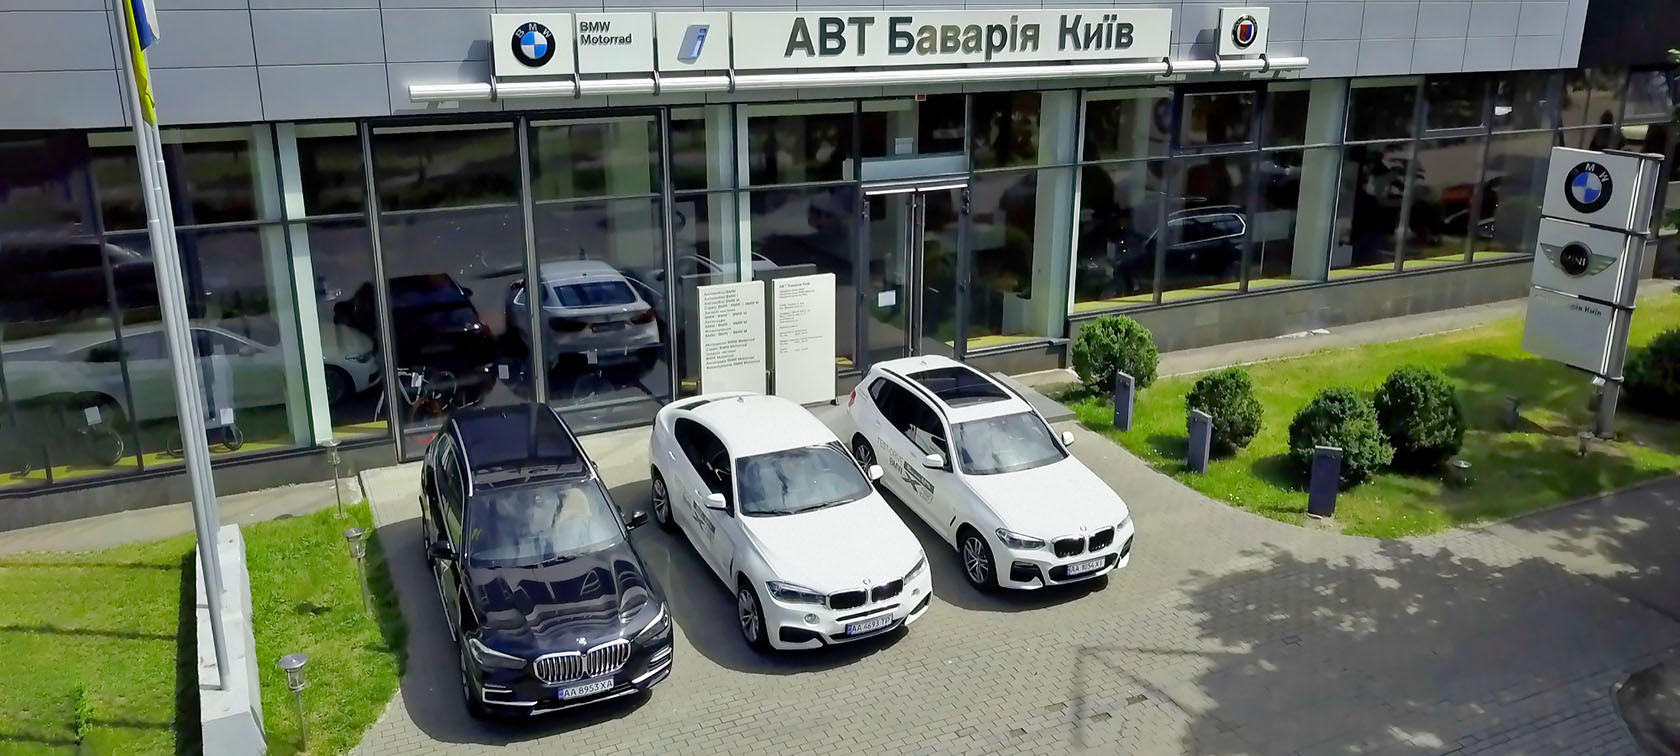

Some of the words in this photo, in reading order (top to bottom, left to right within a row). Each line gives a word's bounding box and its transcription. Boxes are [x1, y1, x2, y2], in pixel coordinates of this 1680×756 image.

[515, 23, 551, 38] BMW
[580, 21, 611, 32] BMW
[580, 33, 632, 45] Motorrad
[784, 16, 875, 58] АВТ
[888, 15, 1040, 62] Баварія
[1058, 13, 1135, 52] Київ
[565, 688, 577, 697] AA
[578, 683, 599, 694] 8953
[600, 680, 613, 689] XA
